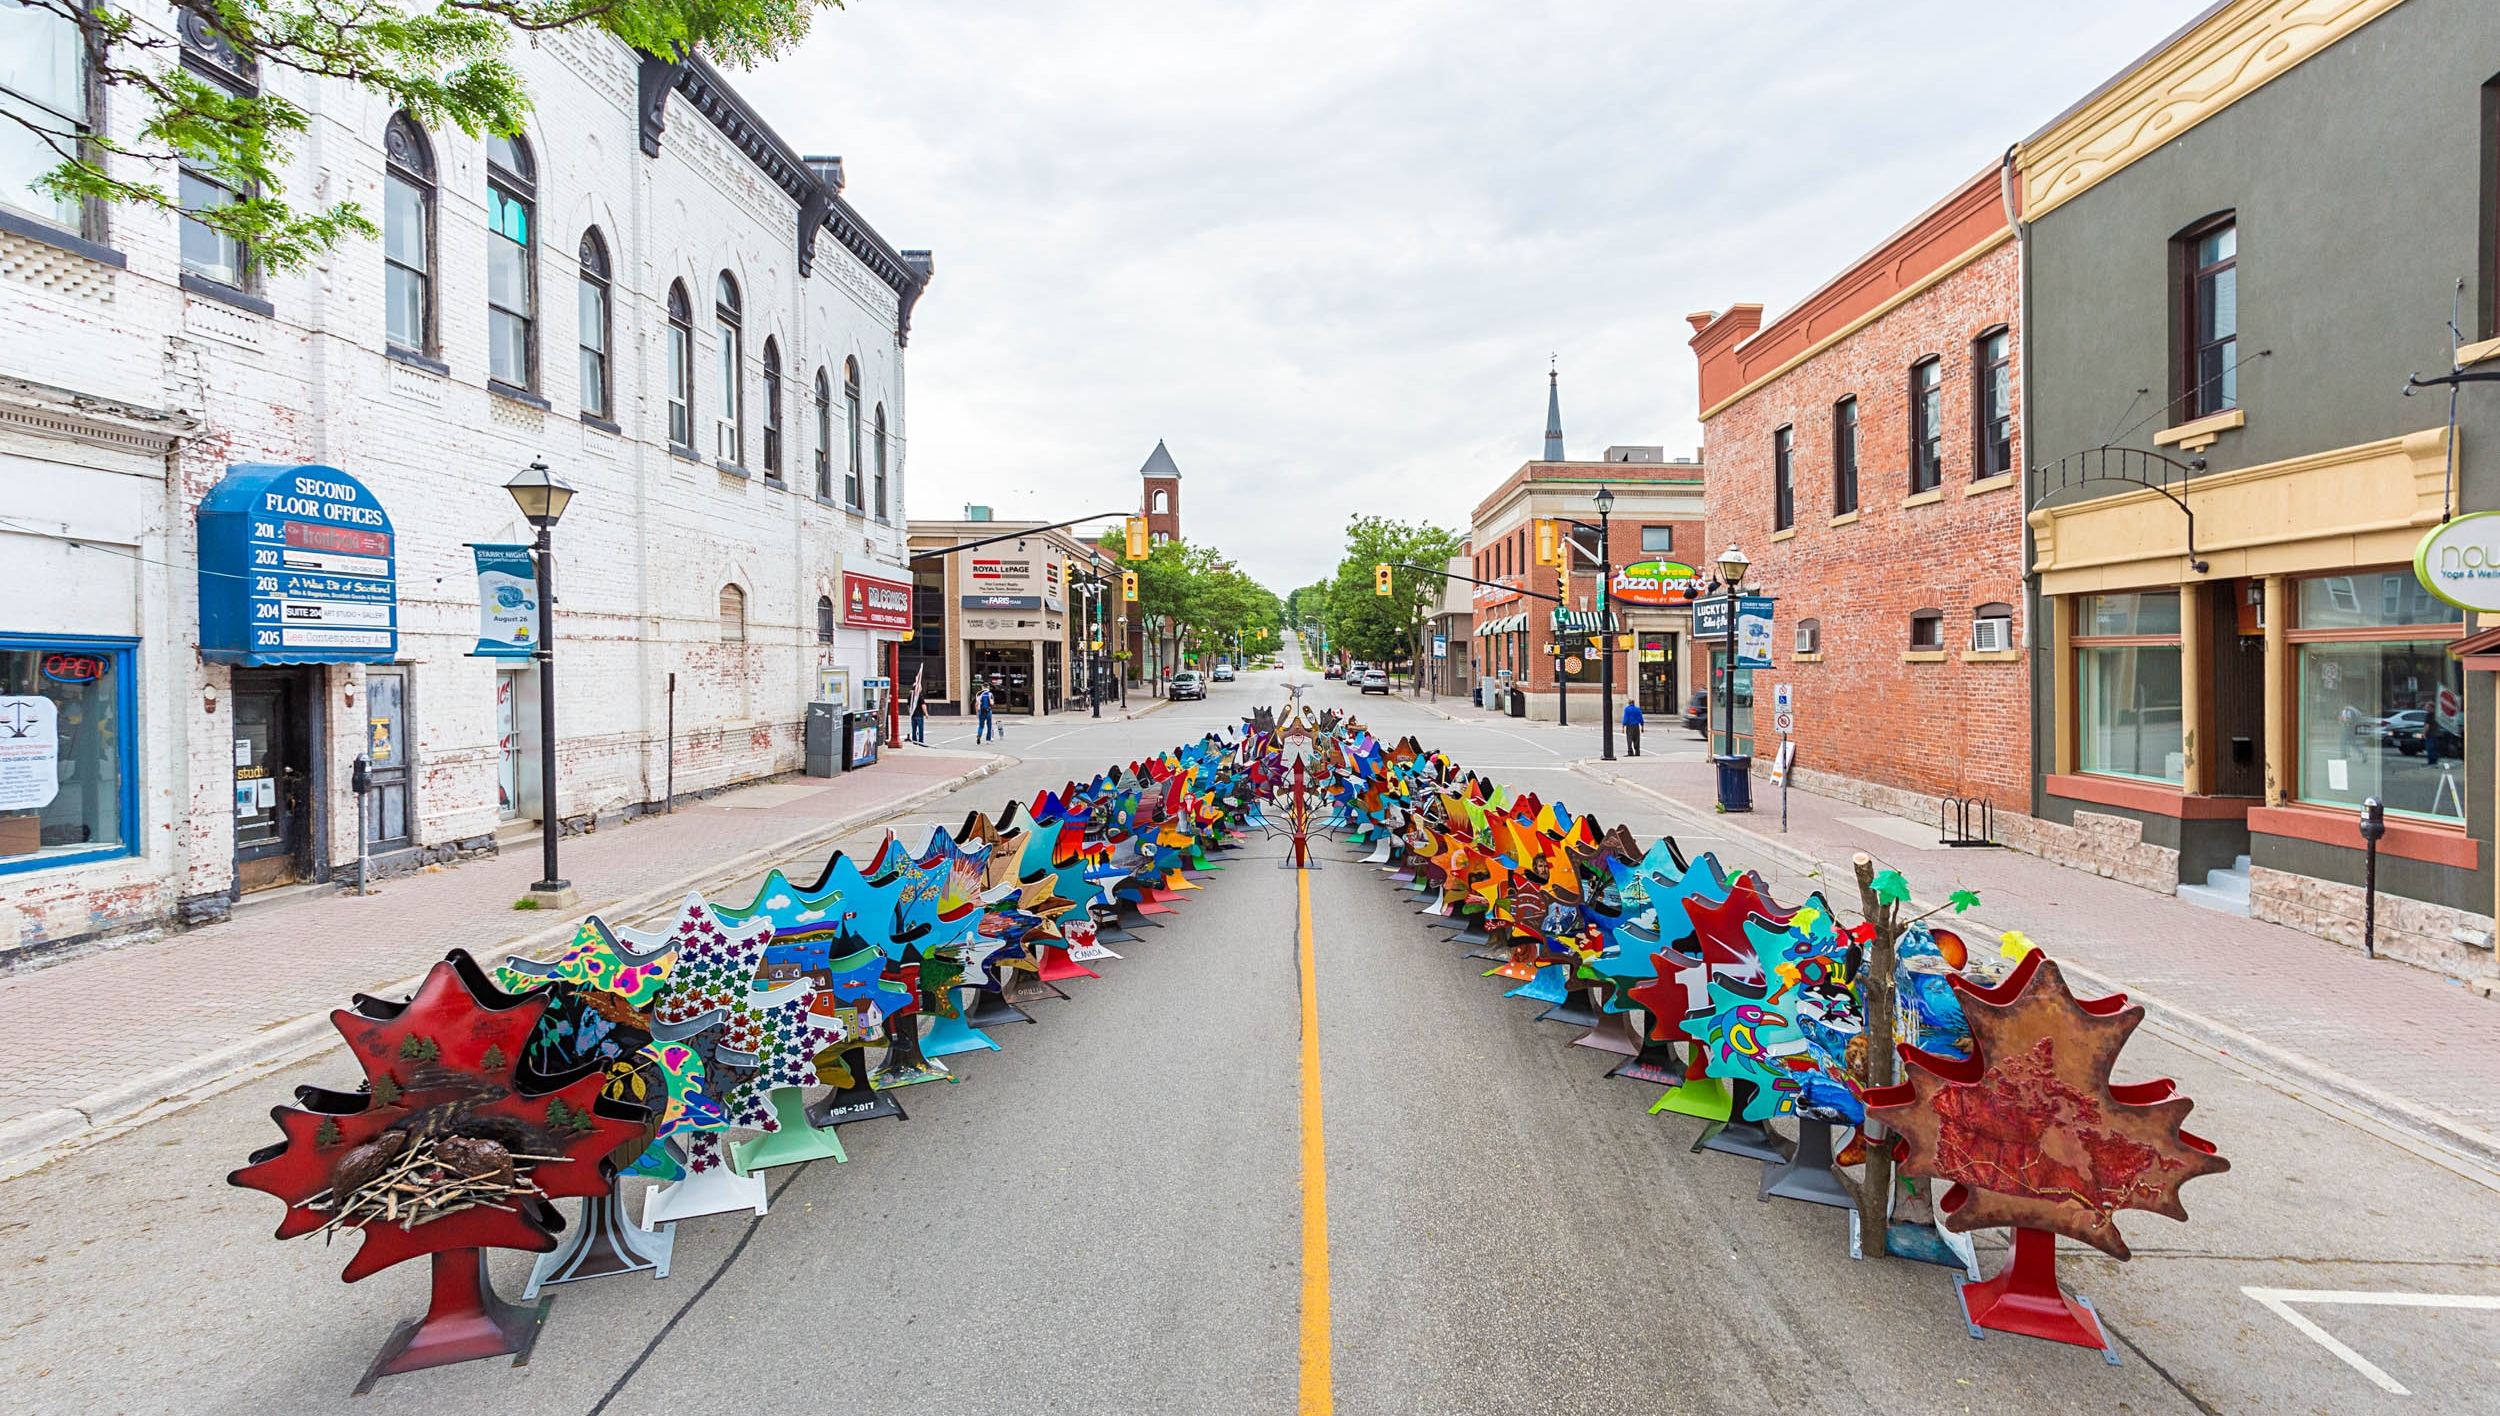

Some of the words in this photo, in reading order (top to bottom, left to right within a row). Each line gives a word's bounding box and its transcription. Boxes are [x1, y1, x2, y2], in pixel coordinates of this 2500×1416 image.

[295, 477, 356, 502] SECOND
[265, 493, 320, 518] FLOOR
[324, 503, 383, 526] OFFICES
[254, 522, 274, 538] 201
[255, 549, 278, 565] 202
[1630, 567, 1651, 575] Hot
[2441, 569, 2464, 579] Yoga
[2467, 570, 2474, 578] &
[256, 576, 279, 592] 203
[288, 577, 300, 588] A
[326, 580, 340, 590] Bit
[342, 581, 352, 591] of
[354, 582, 390, 594] Scotland
[1612, 578, 1658, 594] pizza
[256, 603, 279, 619] 204
[286, 607, 308, 617] SUITE
[1558, 605, 1567, 616] P
[1697, 604, 1720, 616] LUCKY
[493, 615, 518, 623] August
[257, 630, 280, 646] 205
[285, 630, 303, 642] Lee
[306, 632, 372, 645] Contemporary
[46, 655, 104, 681] OPEN
[1074, 948, 1103, 960] CANADA
[1641, 1063, 1662, 1074] 2017
[1626, 1070, 1676, 1085] CANADA
[830, 1101, 875, 1117] 1867-2017
